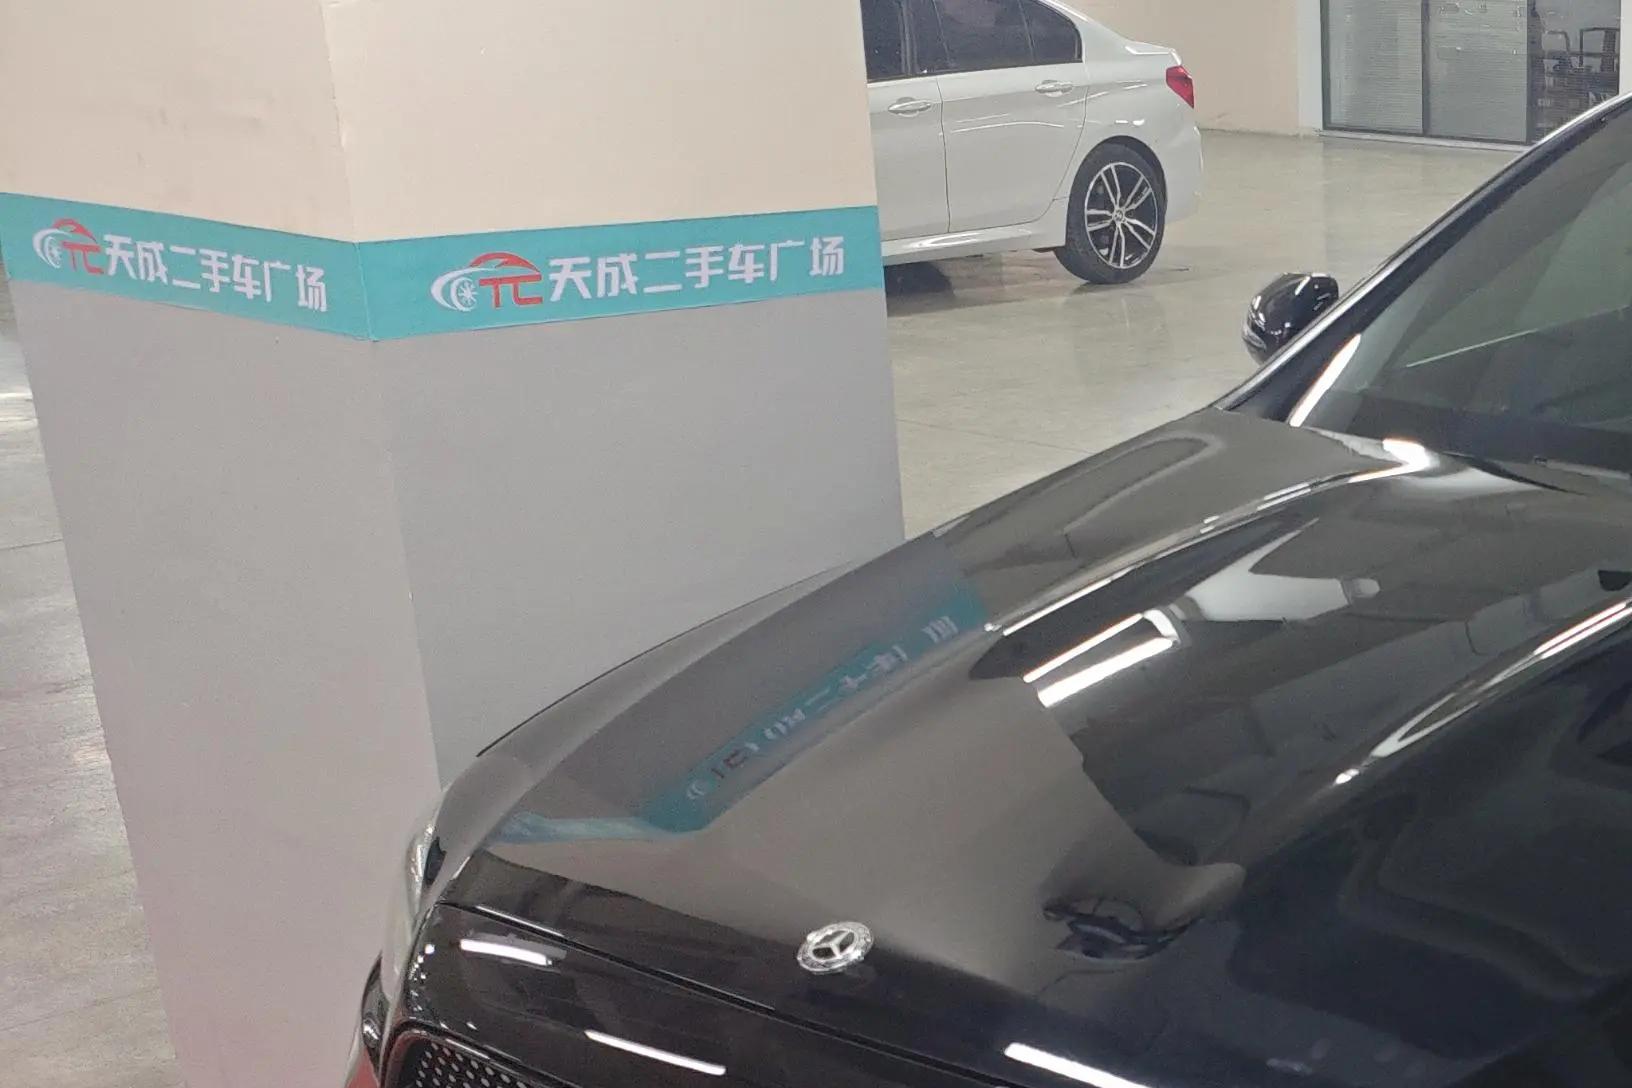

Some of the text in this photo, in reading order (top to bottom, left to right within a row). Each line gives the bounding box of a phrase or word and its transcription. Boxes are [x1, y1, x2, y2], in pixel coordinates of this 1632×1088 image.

[103, 234, 327, 312] 天成二手车广场
[549, 235, 844, 301] 天成二手车广场
